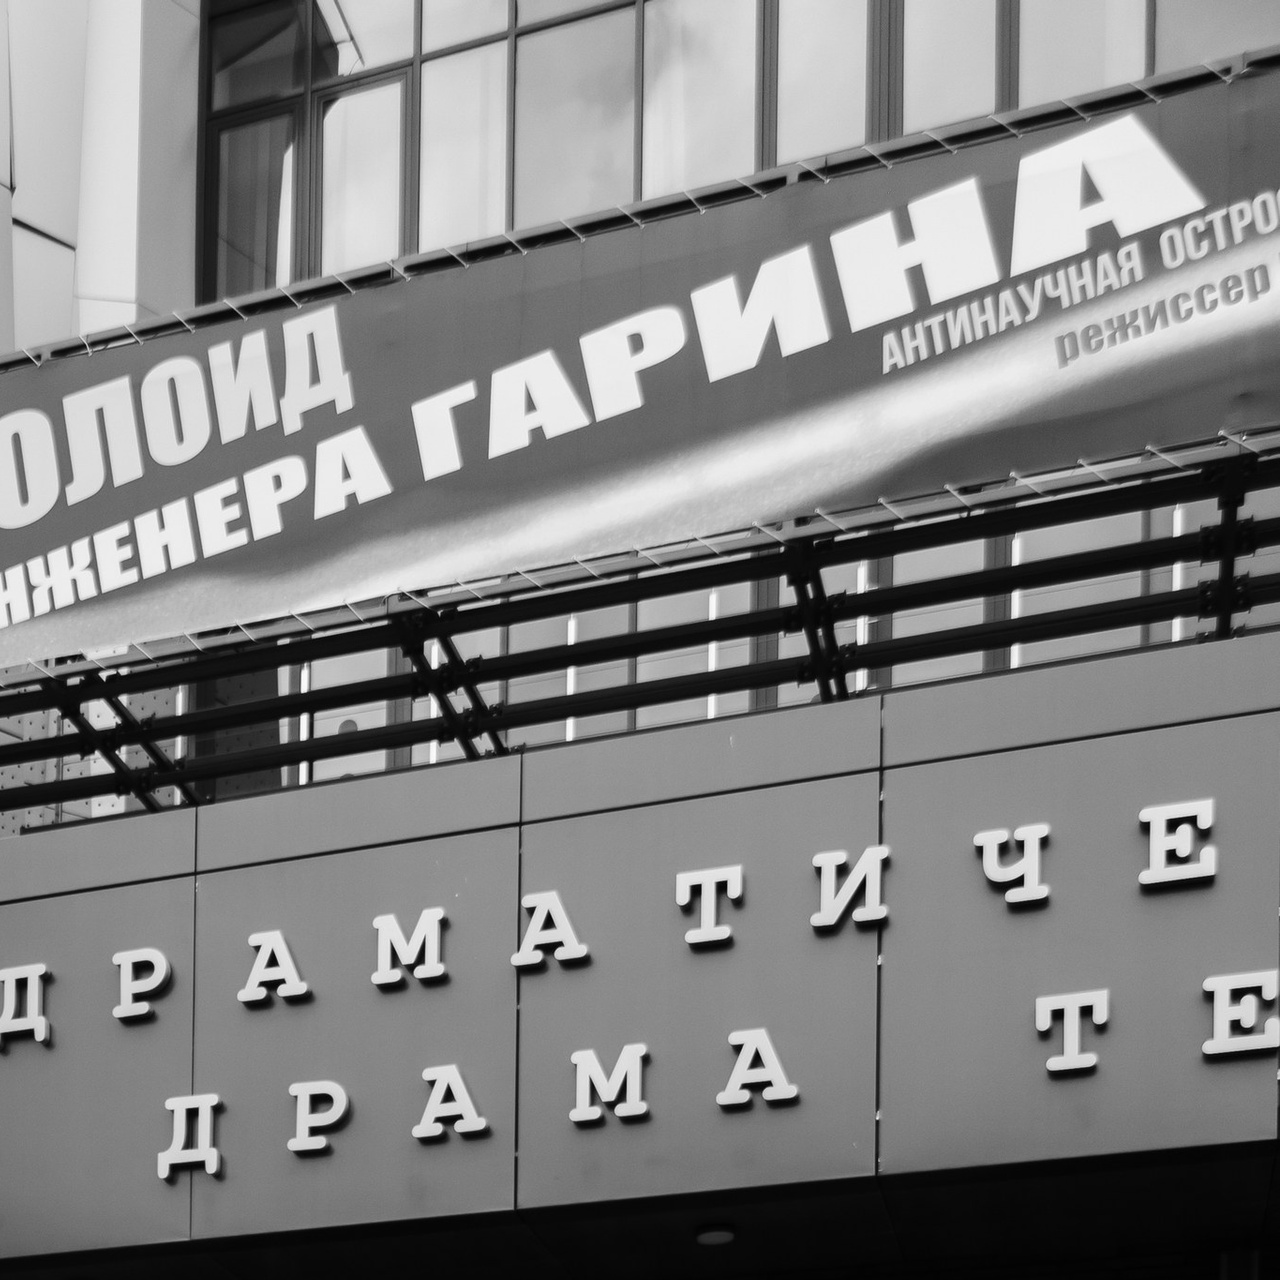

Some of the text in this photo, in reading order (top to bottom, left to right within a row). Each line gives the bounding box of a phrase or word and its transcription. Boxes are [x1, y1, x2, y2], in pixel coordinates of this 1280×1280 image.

[410, 113, 1206, 482] ГАРИНА
[882, 241, 1146, 375] АНТИНАУЧНАЯ
[1158, 187, 1280, 270] ОСТРО
[1054, 263, 1271, 369] режиссер
[157, 1028, 800, 1180] ДРАМА
[1035, 969, 1280, 1072] ТЕ
